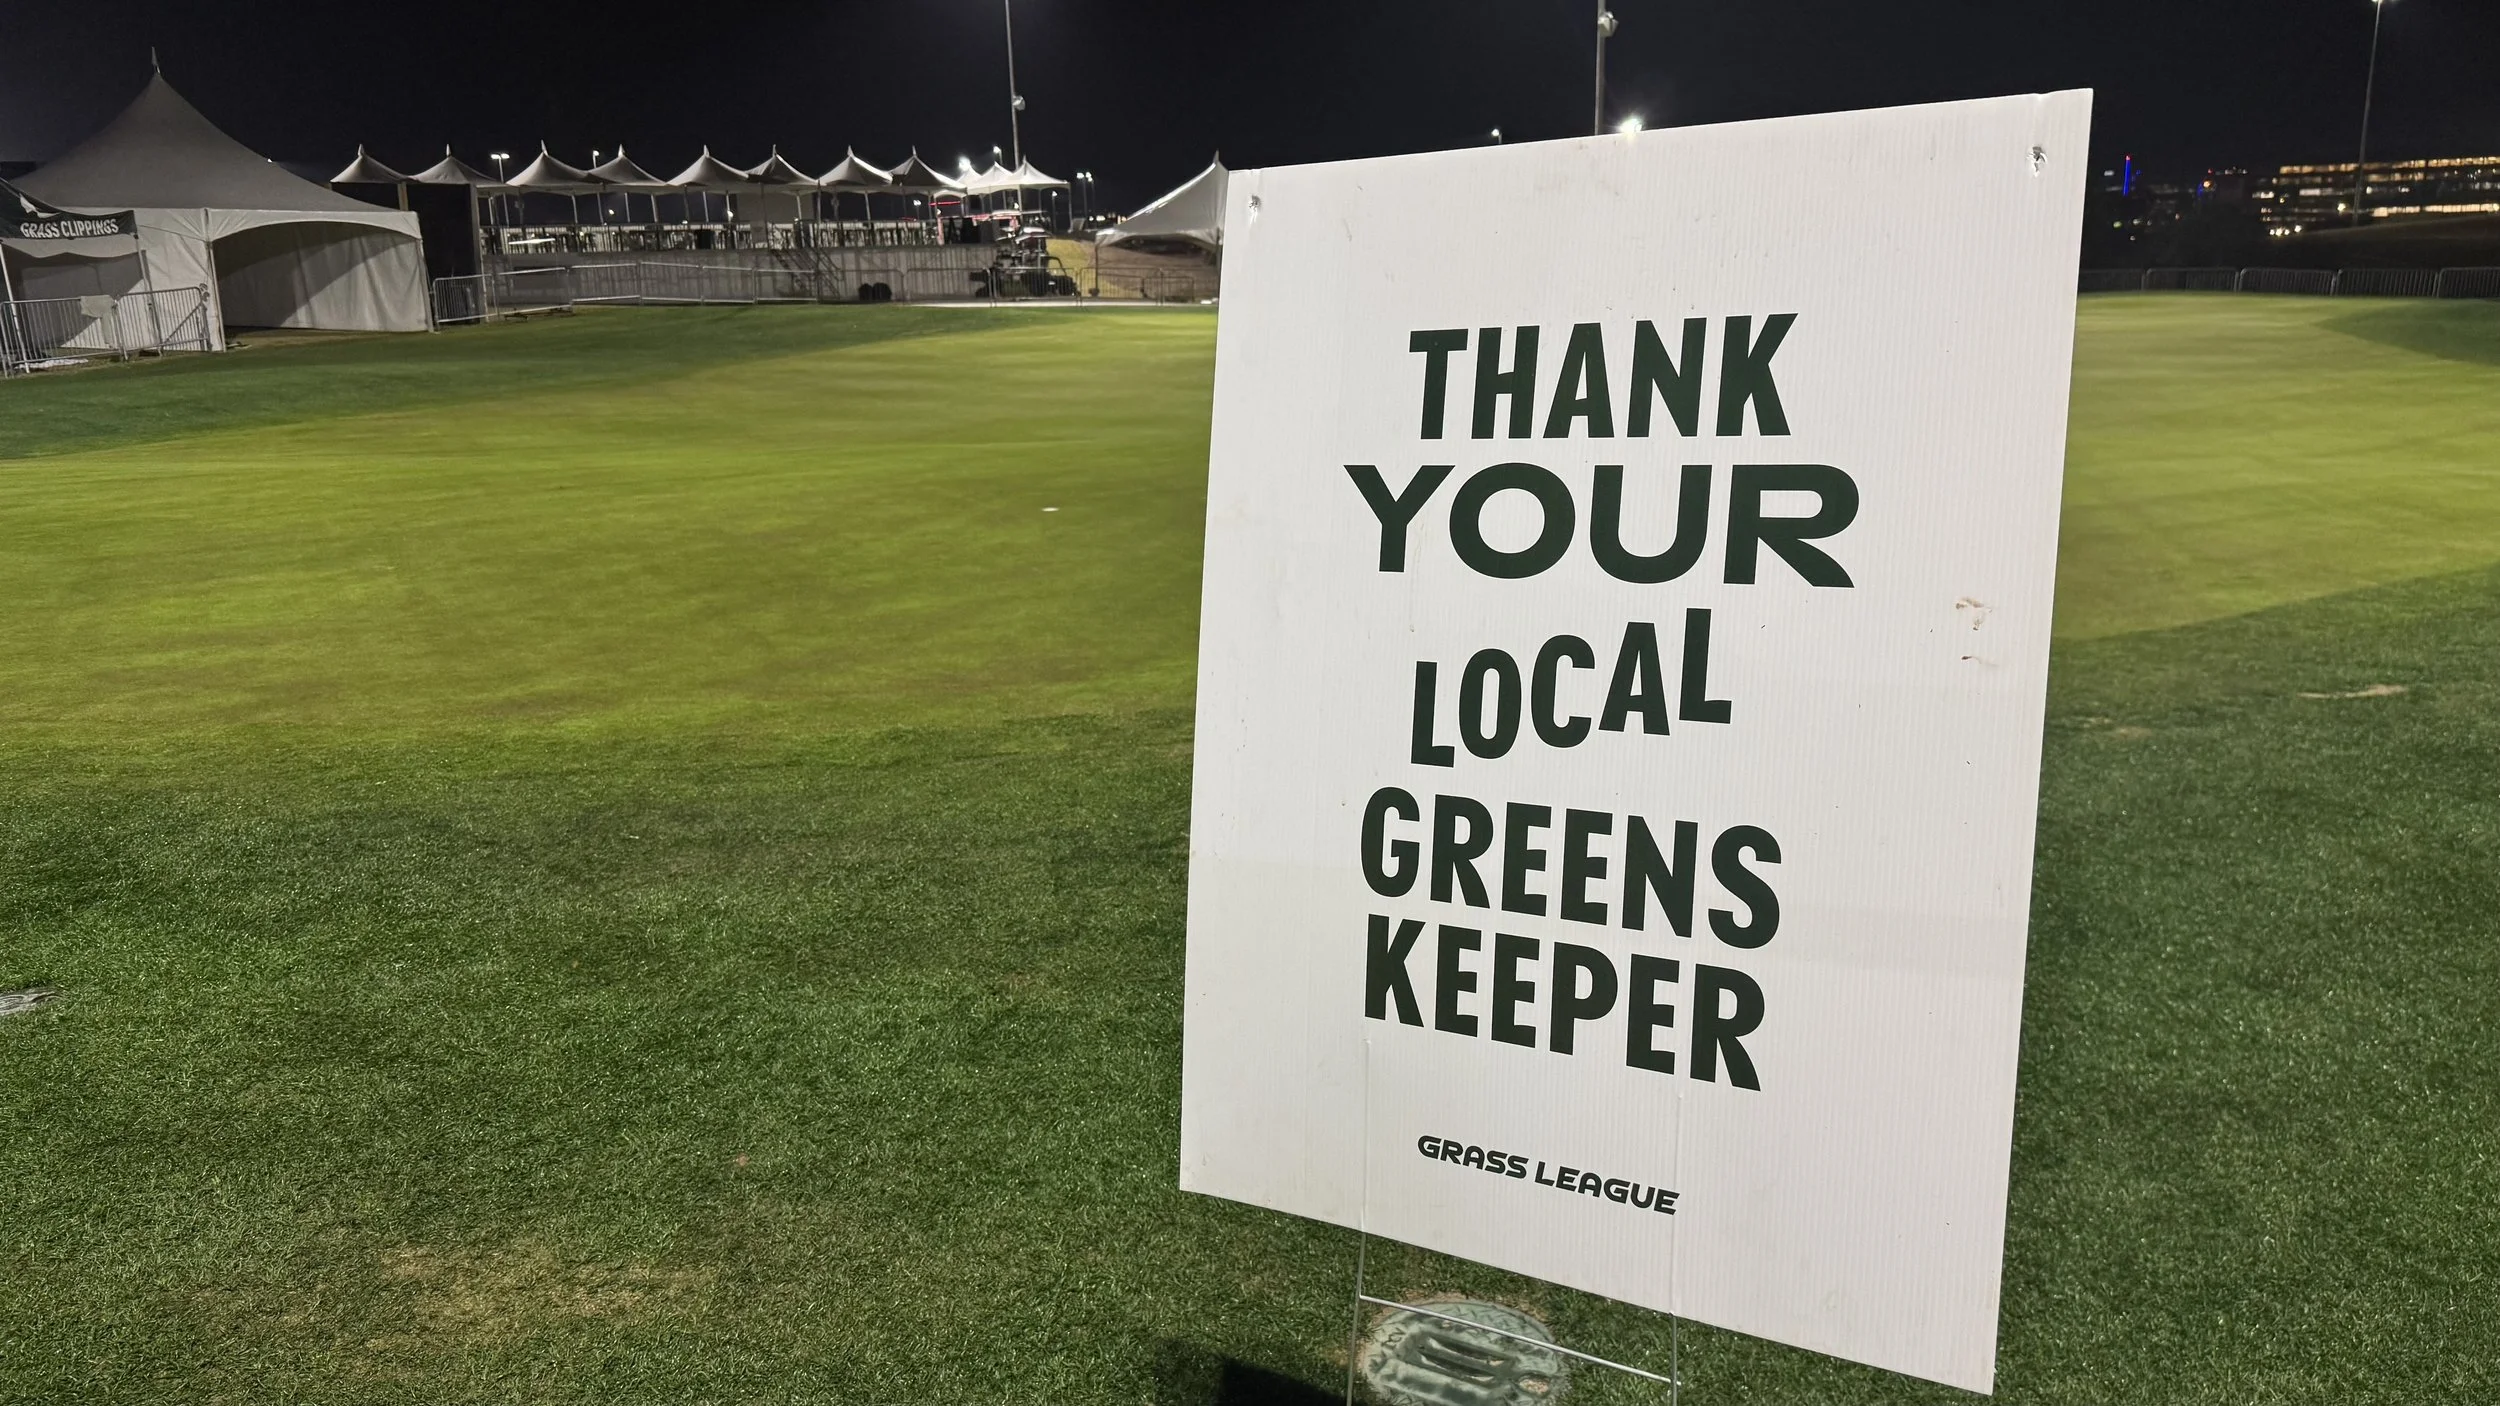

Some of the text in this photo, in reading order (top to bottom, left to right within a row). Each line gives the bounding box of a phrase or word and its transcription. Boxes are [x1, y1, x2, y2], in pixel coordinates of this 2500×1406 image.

[20, 219, 119, 239] GRASS CLIPPINGS
[1408, 312, 1799, 441] THANK
[1343, 462, 1861, 589] YOUR
[1410, 607, 1733, 769] LOCAL
[1360, 786, 1783, 950] GREENS
[1363, 912, 1766, 1093] KEEPER
[1416, 1134, 1681, 1217] GRASS LEAGUE
